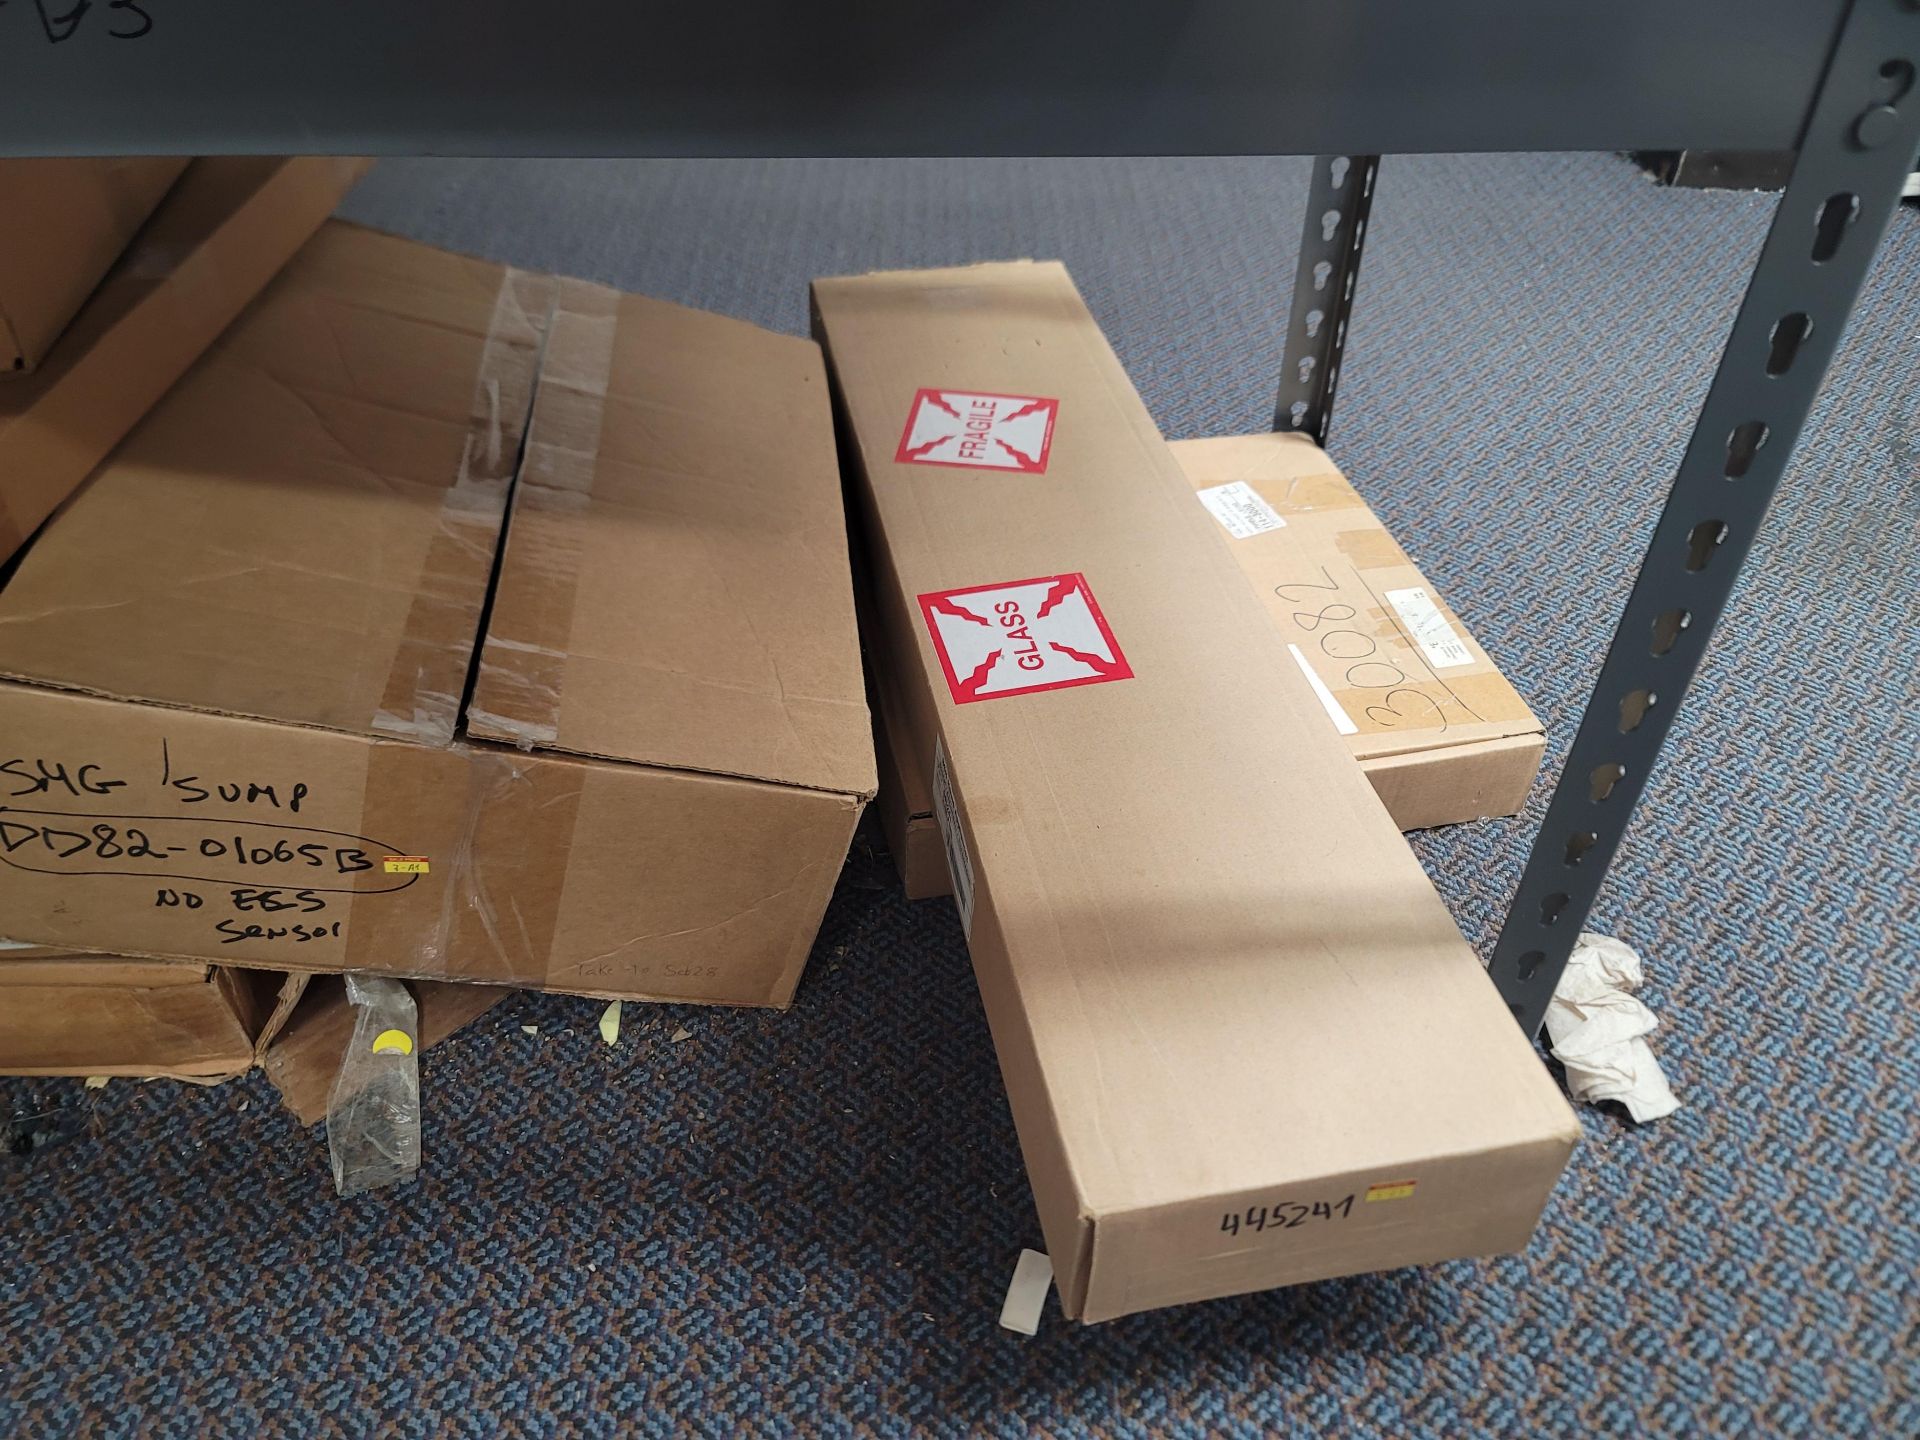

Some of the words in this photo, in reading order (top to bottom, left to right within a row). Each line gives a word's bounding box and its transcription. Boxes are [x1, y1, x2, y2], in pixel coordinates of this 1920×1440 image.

[958, 399, 998, 460] FRAGILE
[994, 600, 1045, 671] GLASS
[1273, 565, 1448, 734] 30082
[1219, 1193, 1356, 1237] 445241
